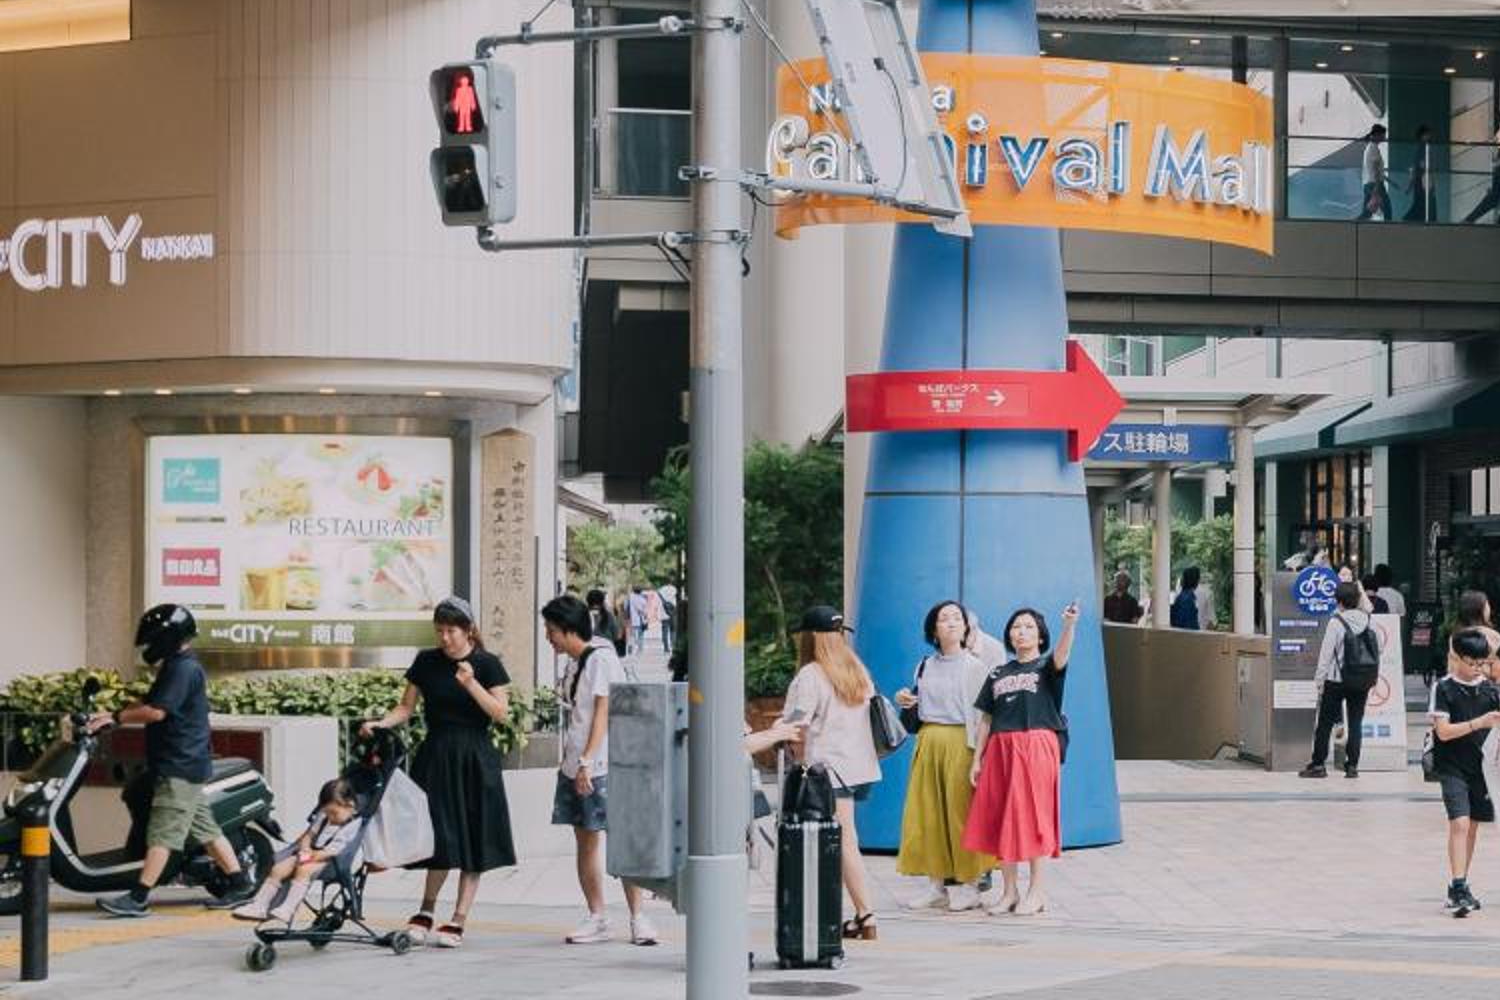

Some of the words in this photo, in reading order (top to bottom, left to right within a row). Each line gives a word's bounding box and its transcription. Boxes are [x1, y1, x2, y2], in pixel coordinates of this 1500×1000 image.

[9, 213, 143, 291] CITY
[289, 518, 434, 537] RESTAURANT
[229, 623, 274, 644] CITY
